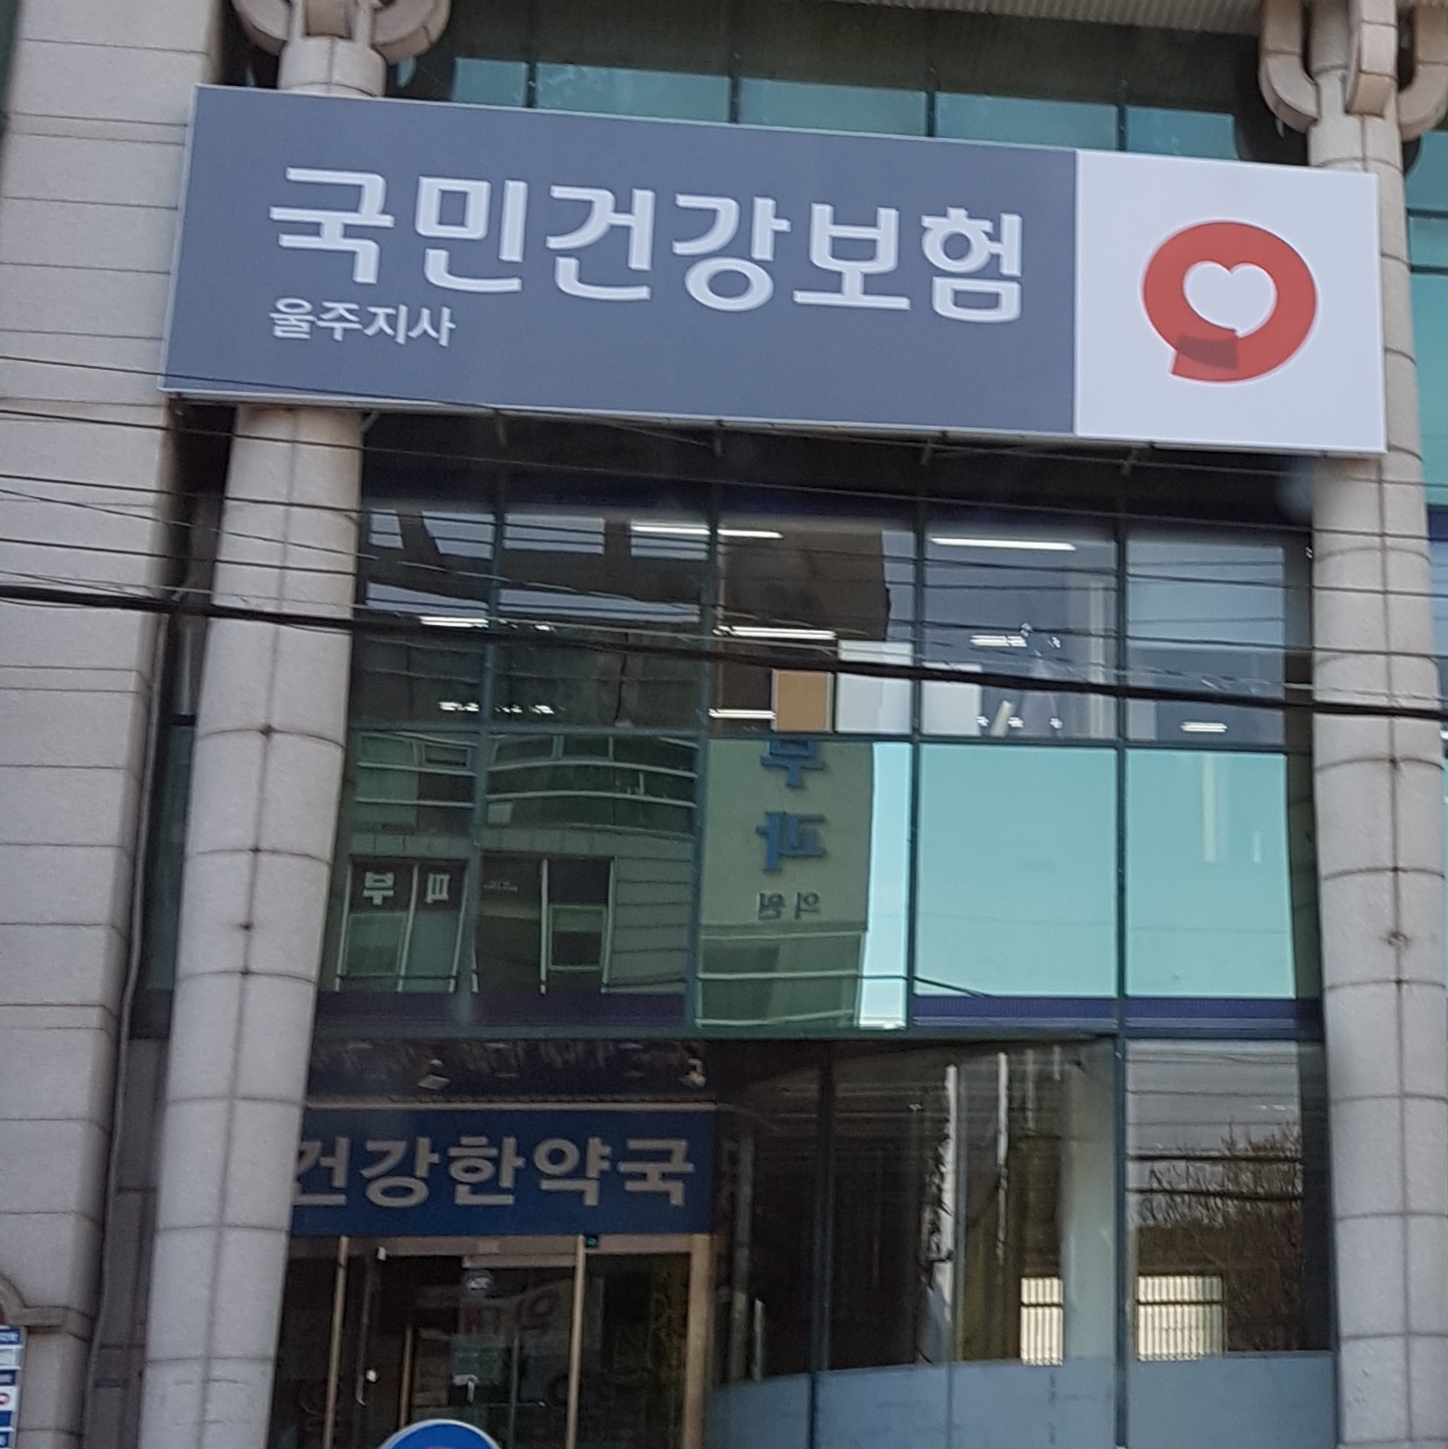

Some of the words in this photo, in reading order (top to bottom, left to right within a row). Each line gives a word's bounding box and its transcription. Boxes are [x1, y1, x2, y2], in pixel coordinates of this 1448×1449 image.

[269, 166, 1022, 324] 국민건강보험
[269, 297, 456, 348] 울주지사
[292, 1135, 694, 1207] 건강한약국
